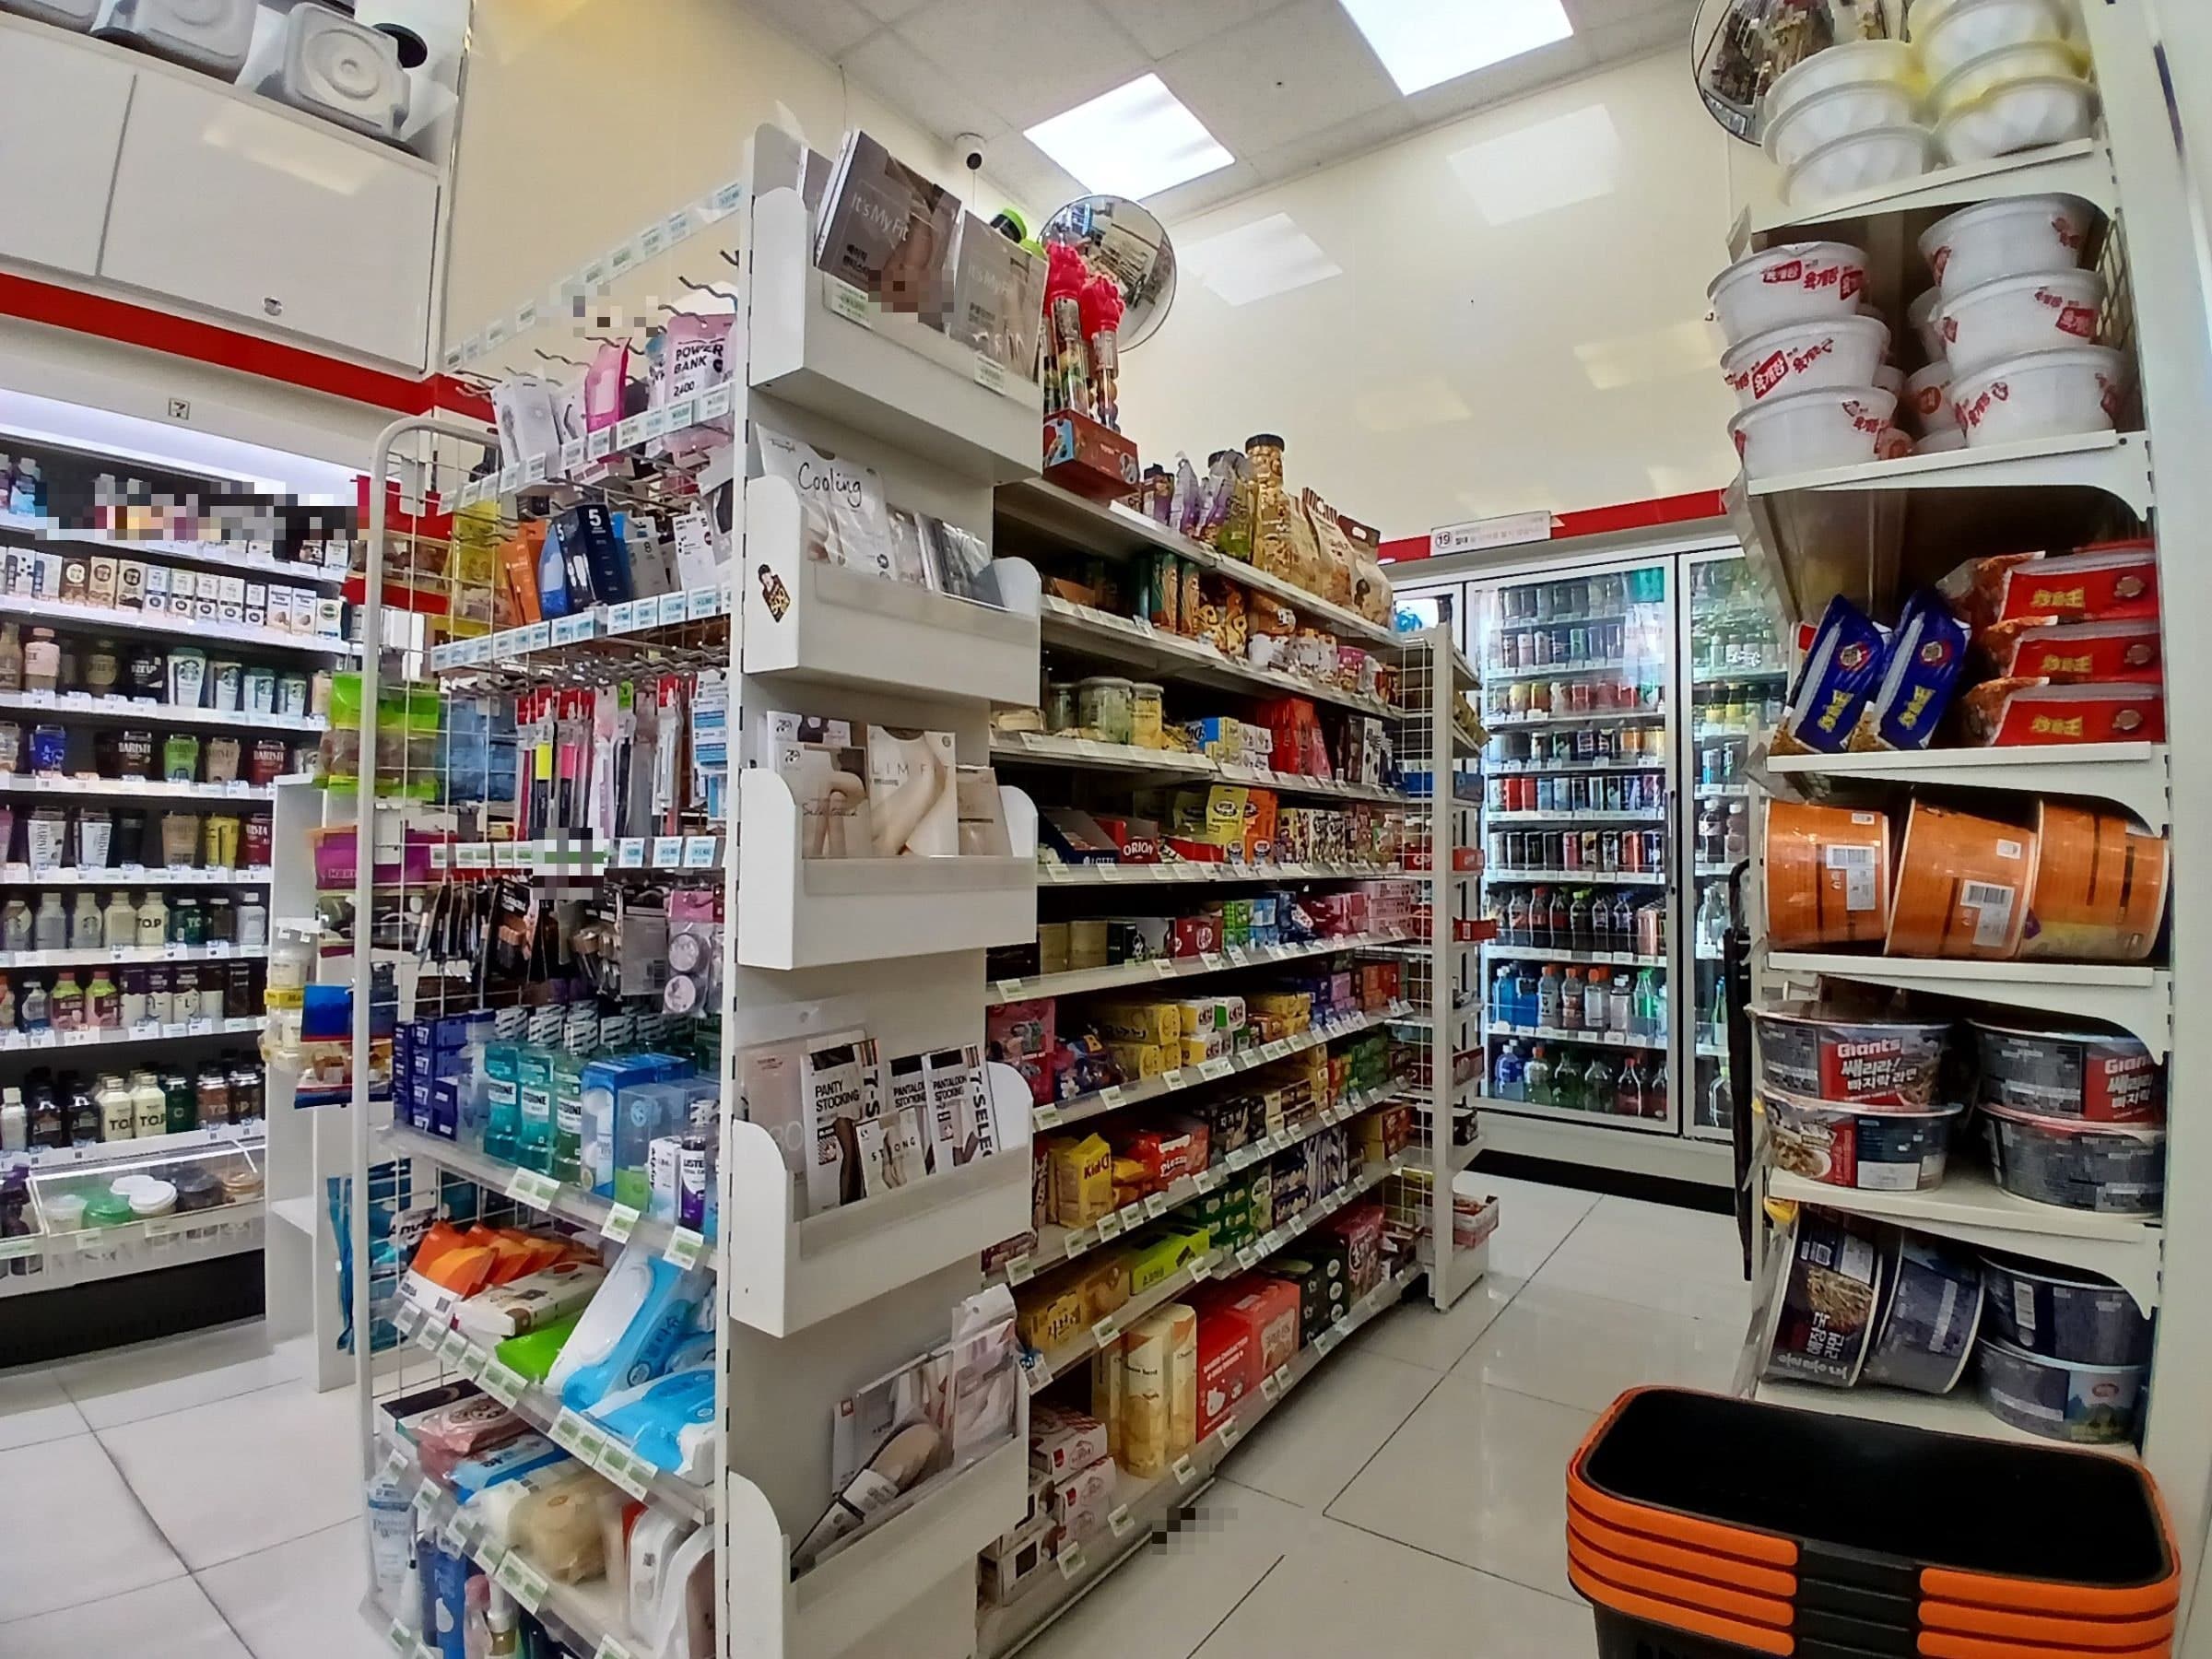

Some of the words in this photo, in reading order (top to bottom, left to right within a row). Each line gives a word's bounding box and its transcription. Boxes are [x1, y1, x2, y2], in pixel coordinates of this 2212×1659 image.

[851, 192, 869, 217] It's
[870, 204, 893, 234] My
[891, 218, 910, 242] Fit
[676, 344, 724, 361] POWER
[674, 355, 708, 374] BANK
[798, 462, 862, 508] Cooling
[588, 508, 602, 526] 5
[1123, 841, 1153, 857] ORION
[1090, 856, 1117, 865] LOTTE
[1837, 1038, 1901, 1058] Giants
[2104, 1056, 2151, 1076] Gian
[815, 1078, 844, 1099] PANTY
[933, 1074, 969, 1090] PANTALOON
[815, 1089, 861, 1113] STOCKING
[935, 1087, 965, 1102] STOCKING
[870, 1135, 917, 1163] STONG
[683, 1159, 704, 1169] LISTE
[1823, 1331, 1845, 1360] 라면
